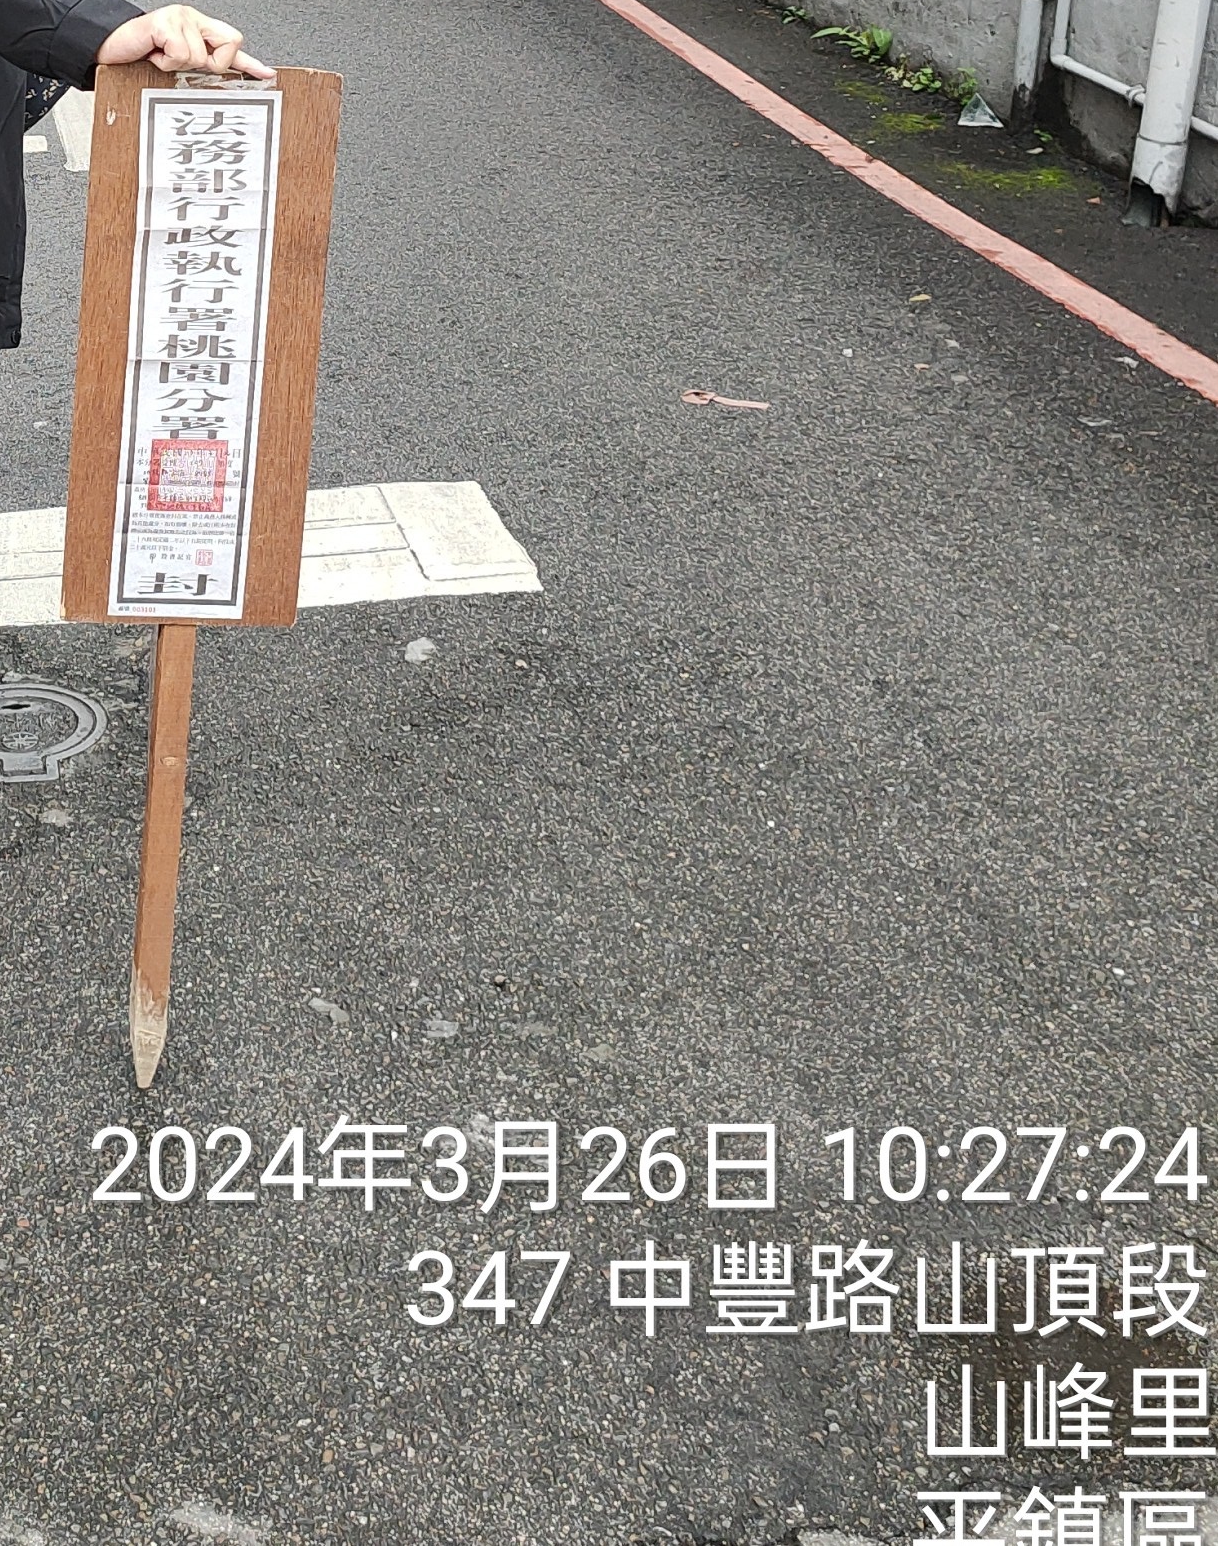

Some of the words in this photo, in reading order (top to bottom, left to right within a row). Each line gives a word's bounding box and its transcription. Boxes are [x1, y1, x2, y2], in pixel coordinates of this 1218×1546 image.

[152, 110, 251, 439] 法務部行政執行署桃園分署
[137, 572, 219, 596] 封
